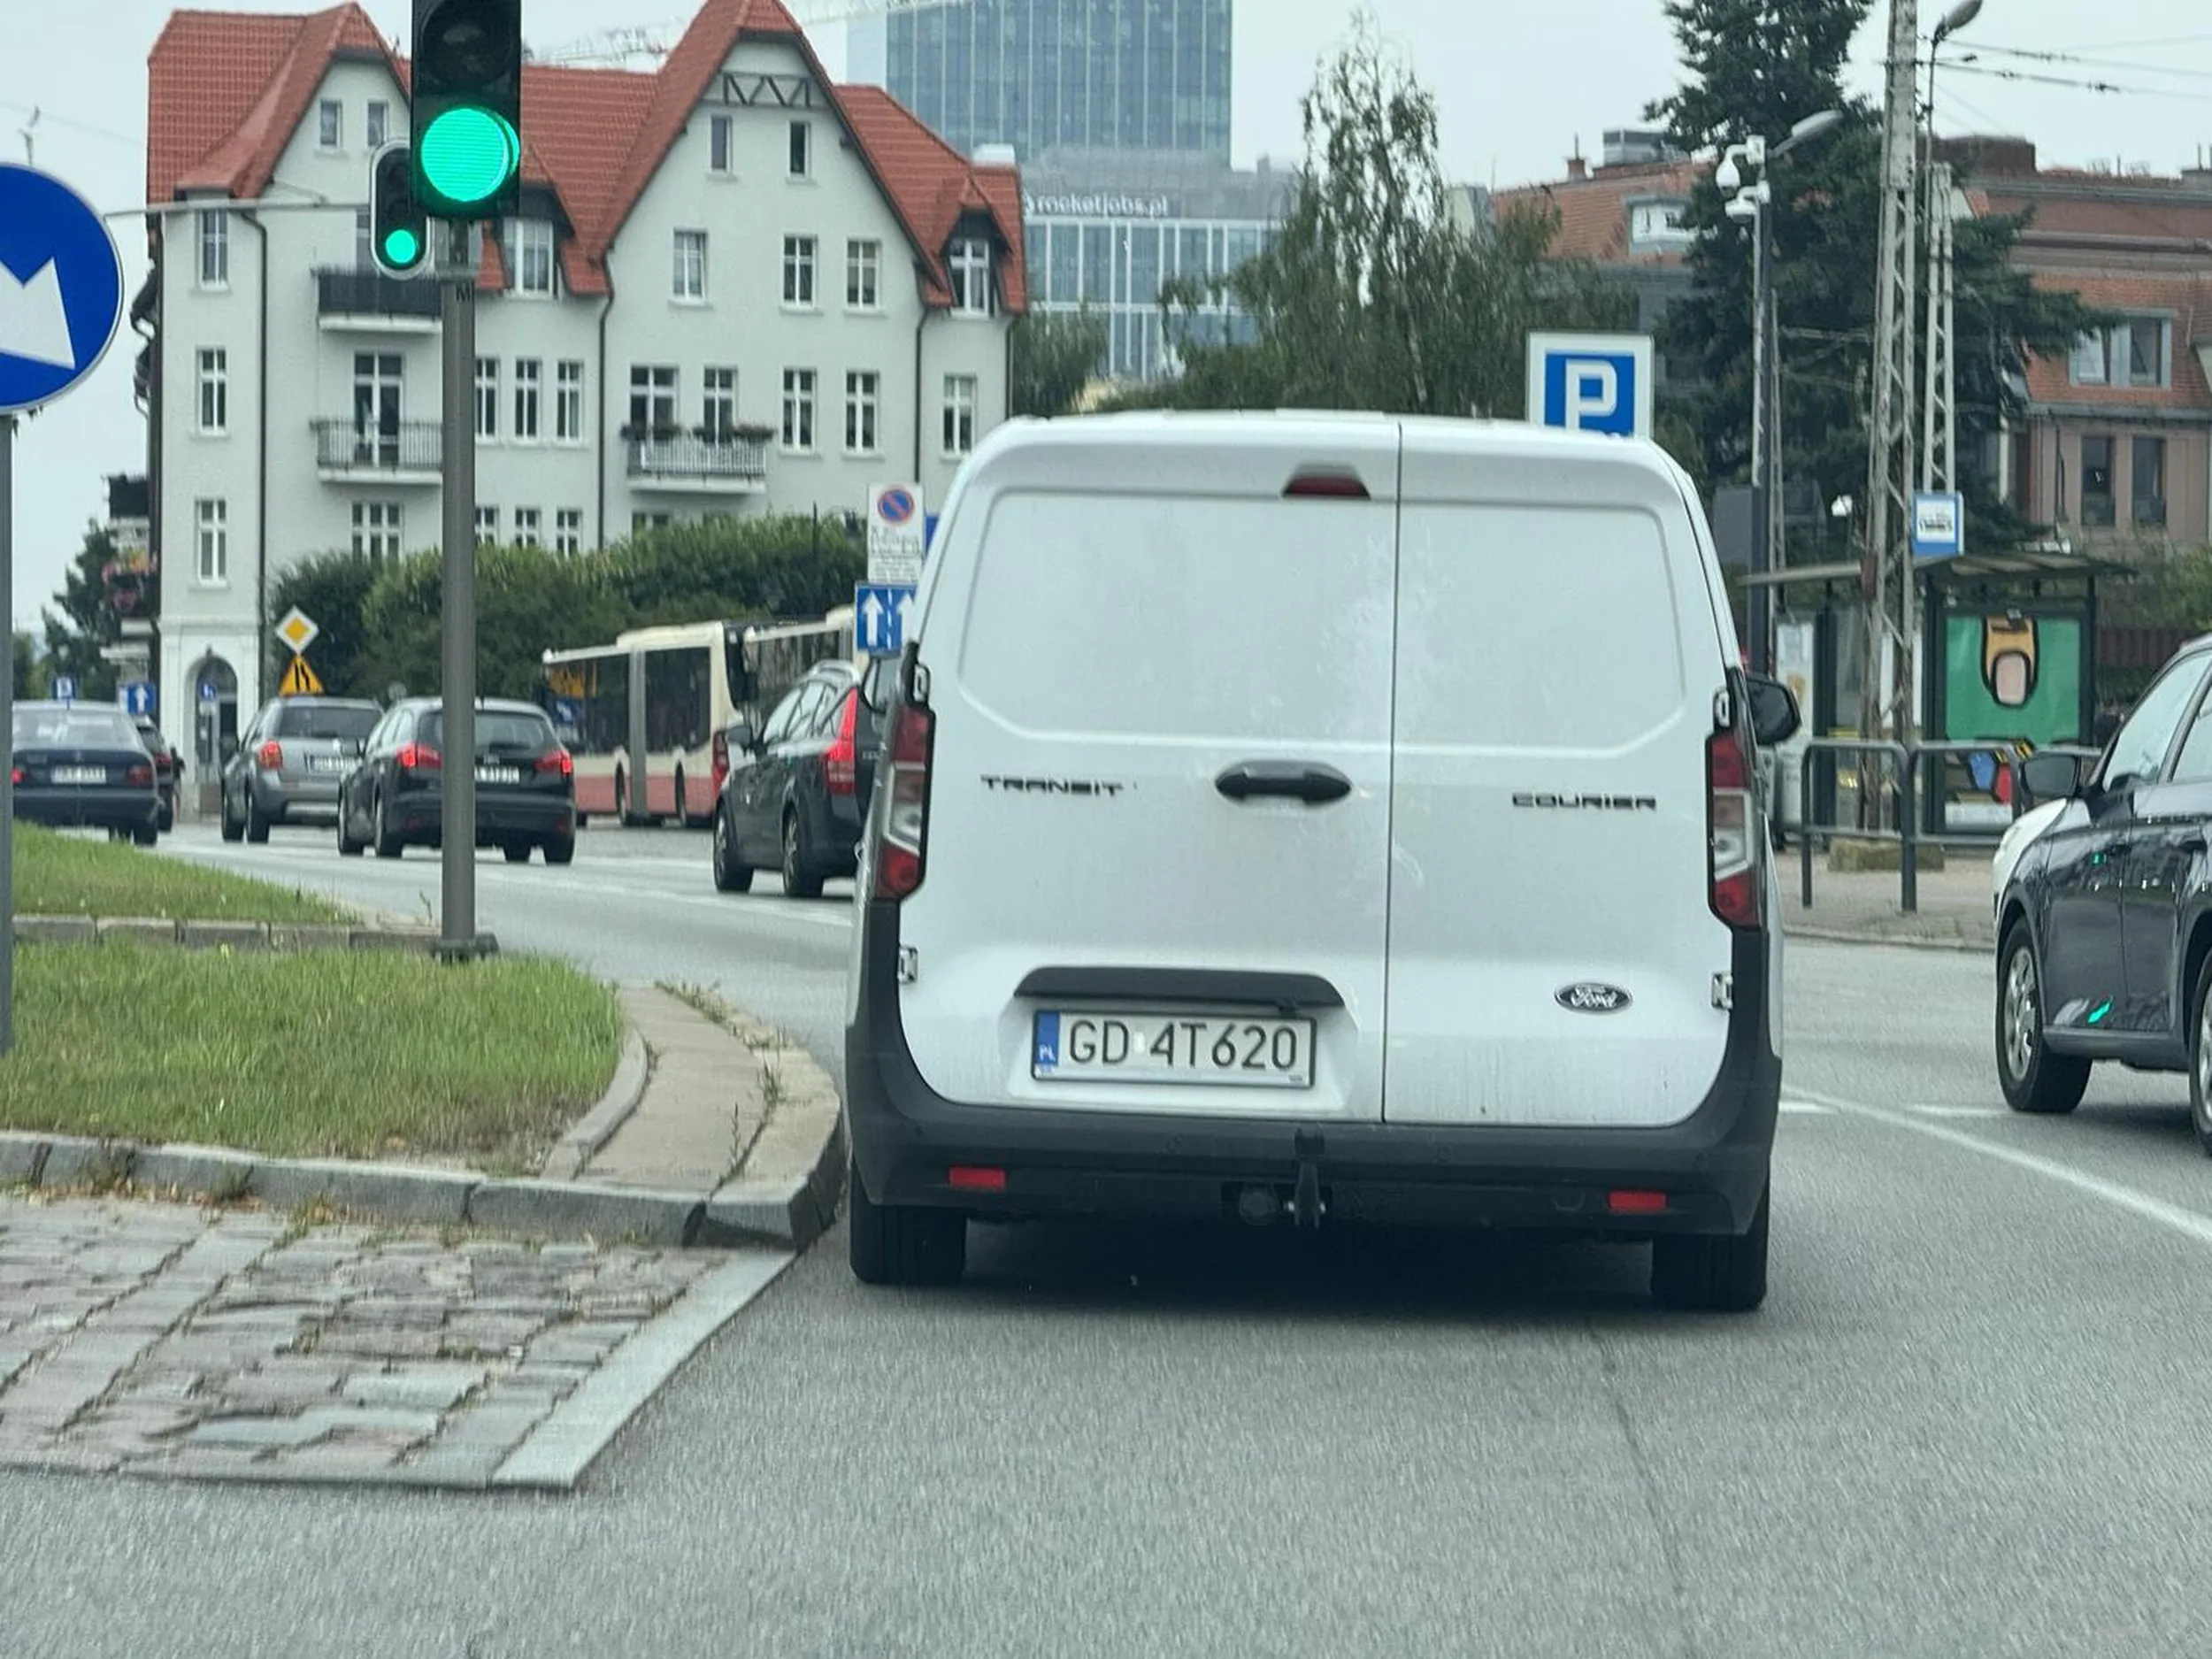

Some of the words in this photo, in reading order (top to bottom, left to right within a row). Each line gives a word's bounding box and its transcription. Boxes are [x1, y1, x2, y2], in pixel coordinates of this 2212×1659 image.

[1037, 192, 1168, 221] rocketjobs.pl
[1565, 359, 1617, 432] P
[980, 773, 1124, 797] TRANSIT
[1512, 792, 1656, 811] COURIER
[1571, 985, 1617, 1009] Ford
[1069, 1019, 1130, 1064] GD
[1150, 1021, 1297, 1071] 4T620
